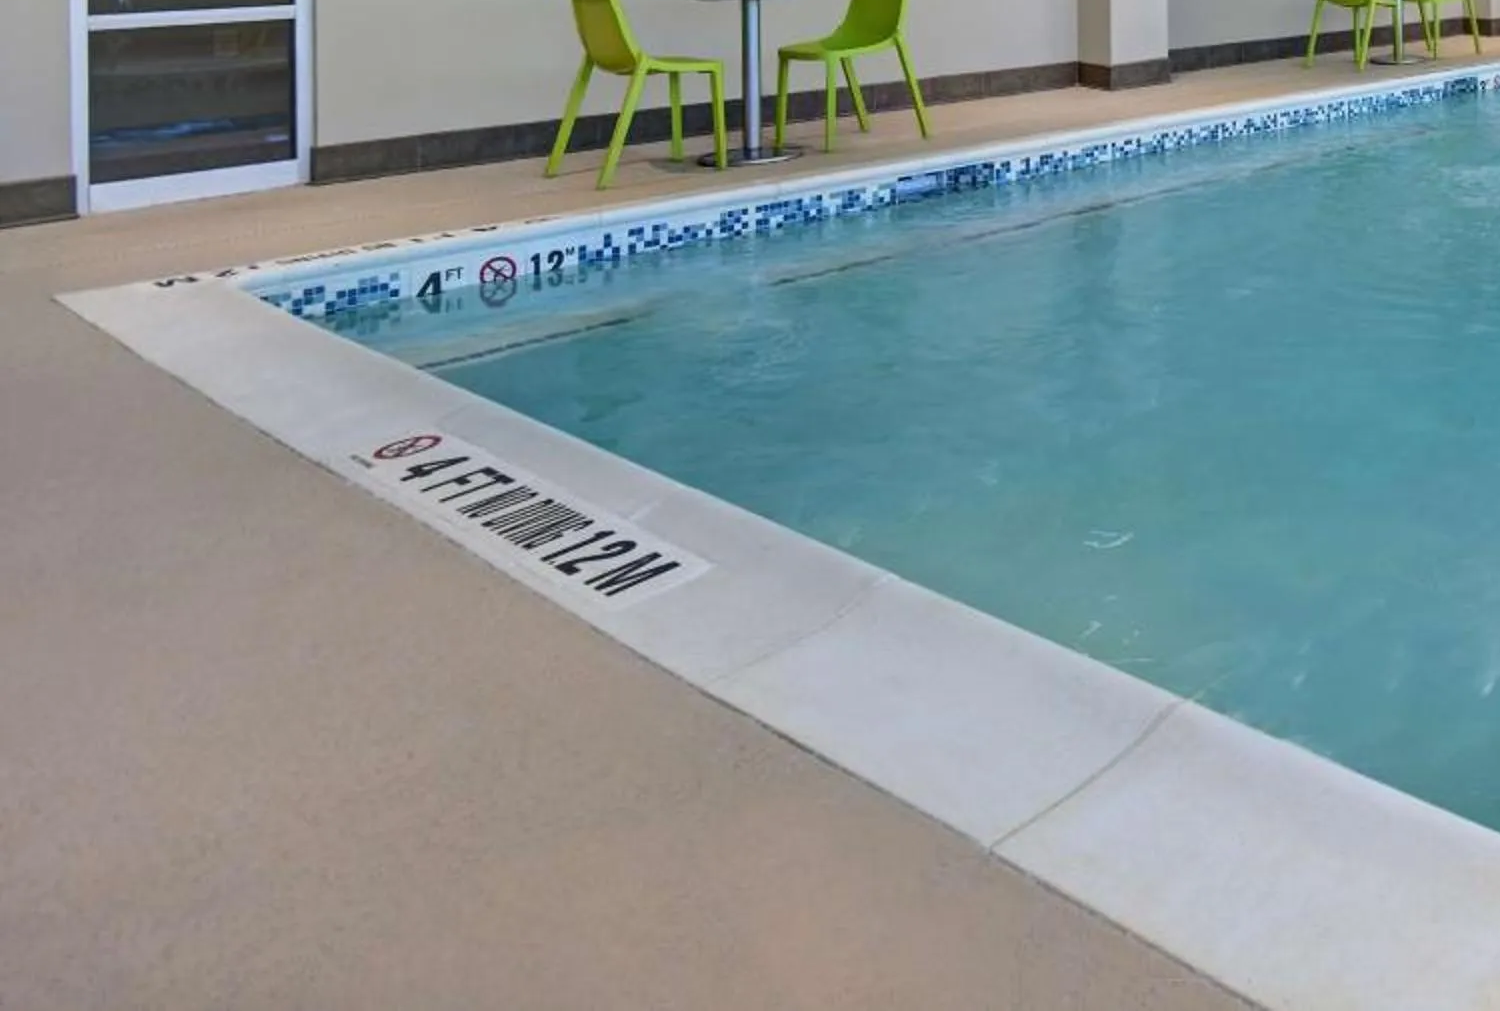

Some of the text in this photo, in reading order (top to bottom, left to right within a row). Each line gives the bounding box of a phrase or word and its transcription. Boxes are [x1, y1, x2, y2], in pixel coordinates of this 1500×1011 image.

[416, 271, 443, 298] 4
[445, 266, 464, 282] FT
[400, 456, 470, 482] 4
[420, 466, 515, 503] FT
[455, 485, 539, 519] NO
[481, 498, 595, 550] DIVING
[584, 552, 681, 597] M
